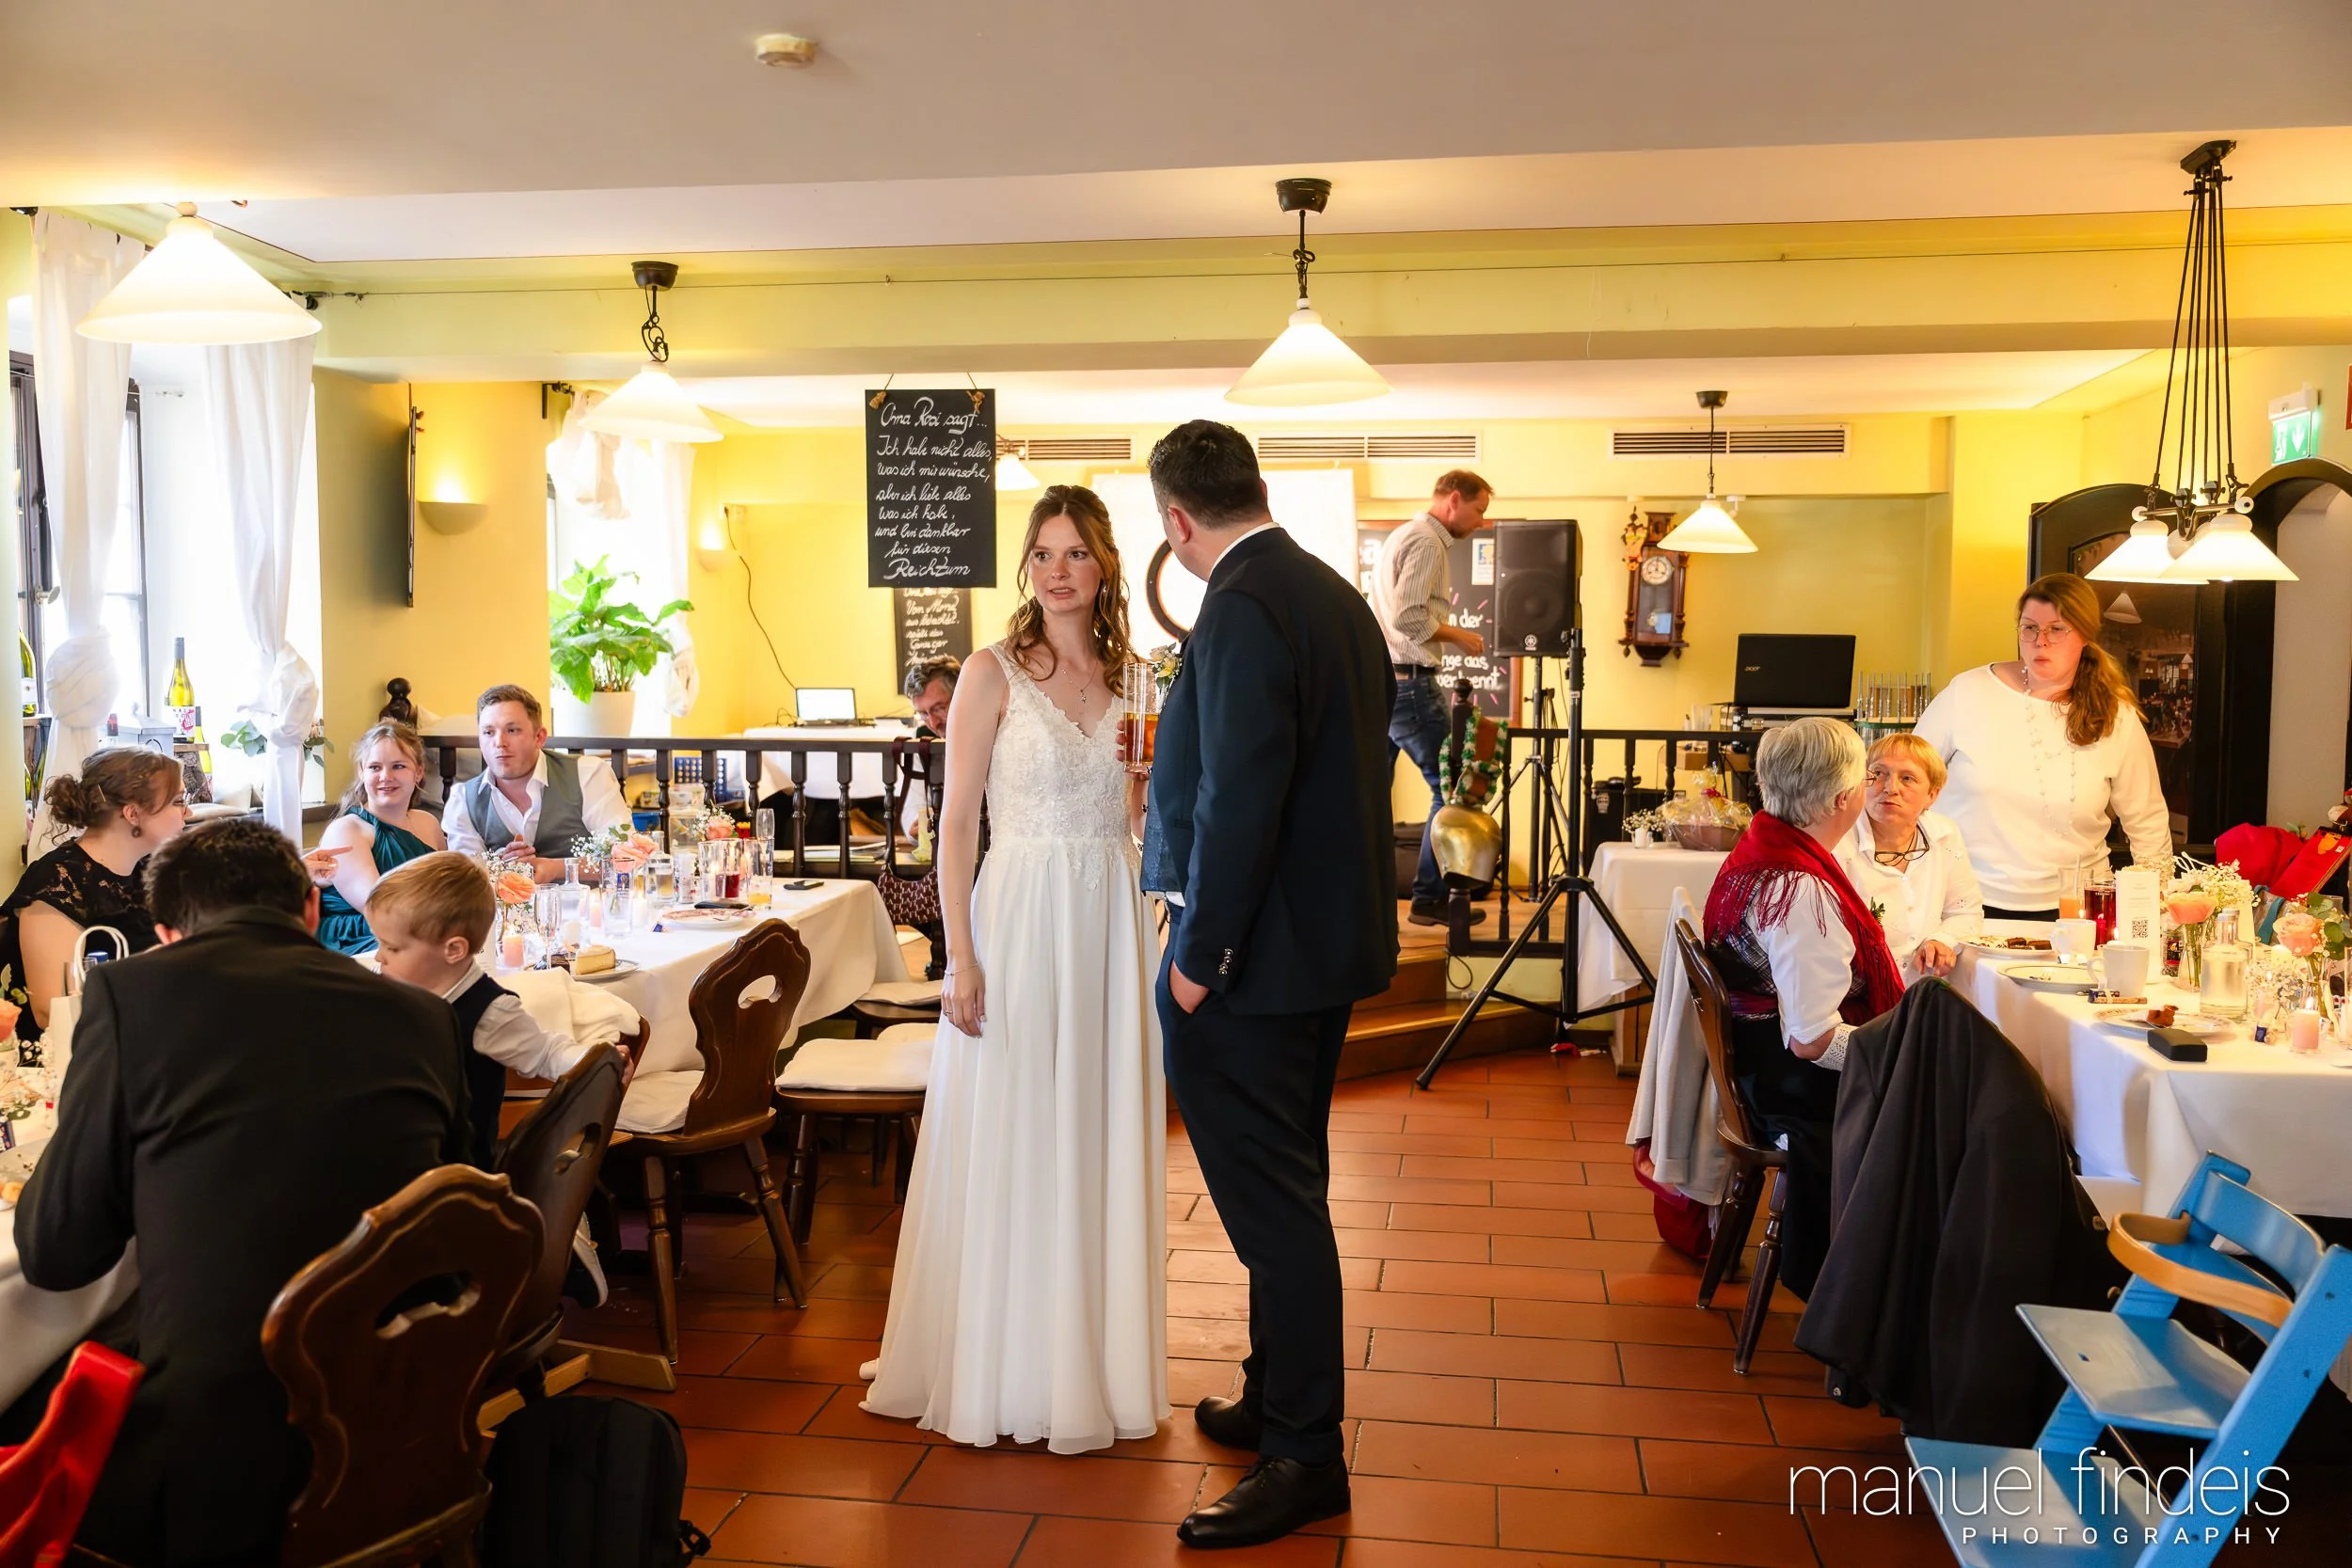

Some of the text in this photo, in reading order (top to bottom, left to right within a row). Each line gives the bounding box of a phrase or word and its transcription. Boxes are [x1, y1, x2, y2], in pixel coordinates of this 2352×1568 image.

[881, 403, 911, 427] Oma
[914, 396, 940, 428] Rosi
[876, 435, 993, 461] Ich habe nicht alles,
[899, 460, 915, 477] ich
[918, 464, 937, 477] mir
[876, 482, 972, 501] aber ich liebe alles
[901, 504, 918, 520] ich
[874, 522, 971, 539] und bin dankbar
[913, 543, 951, 555] diesen
[883, 556, 971, 580] Reichtum
[1459, 608, 1484, 628] der
